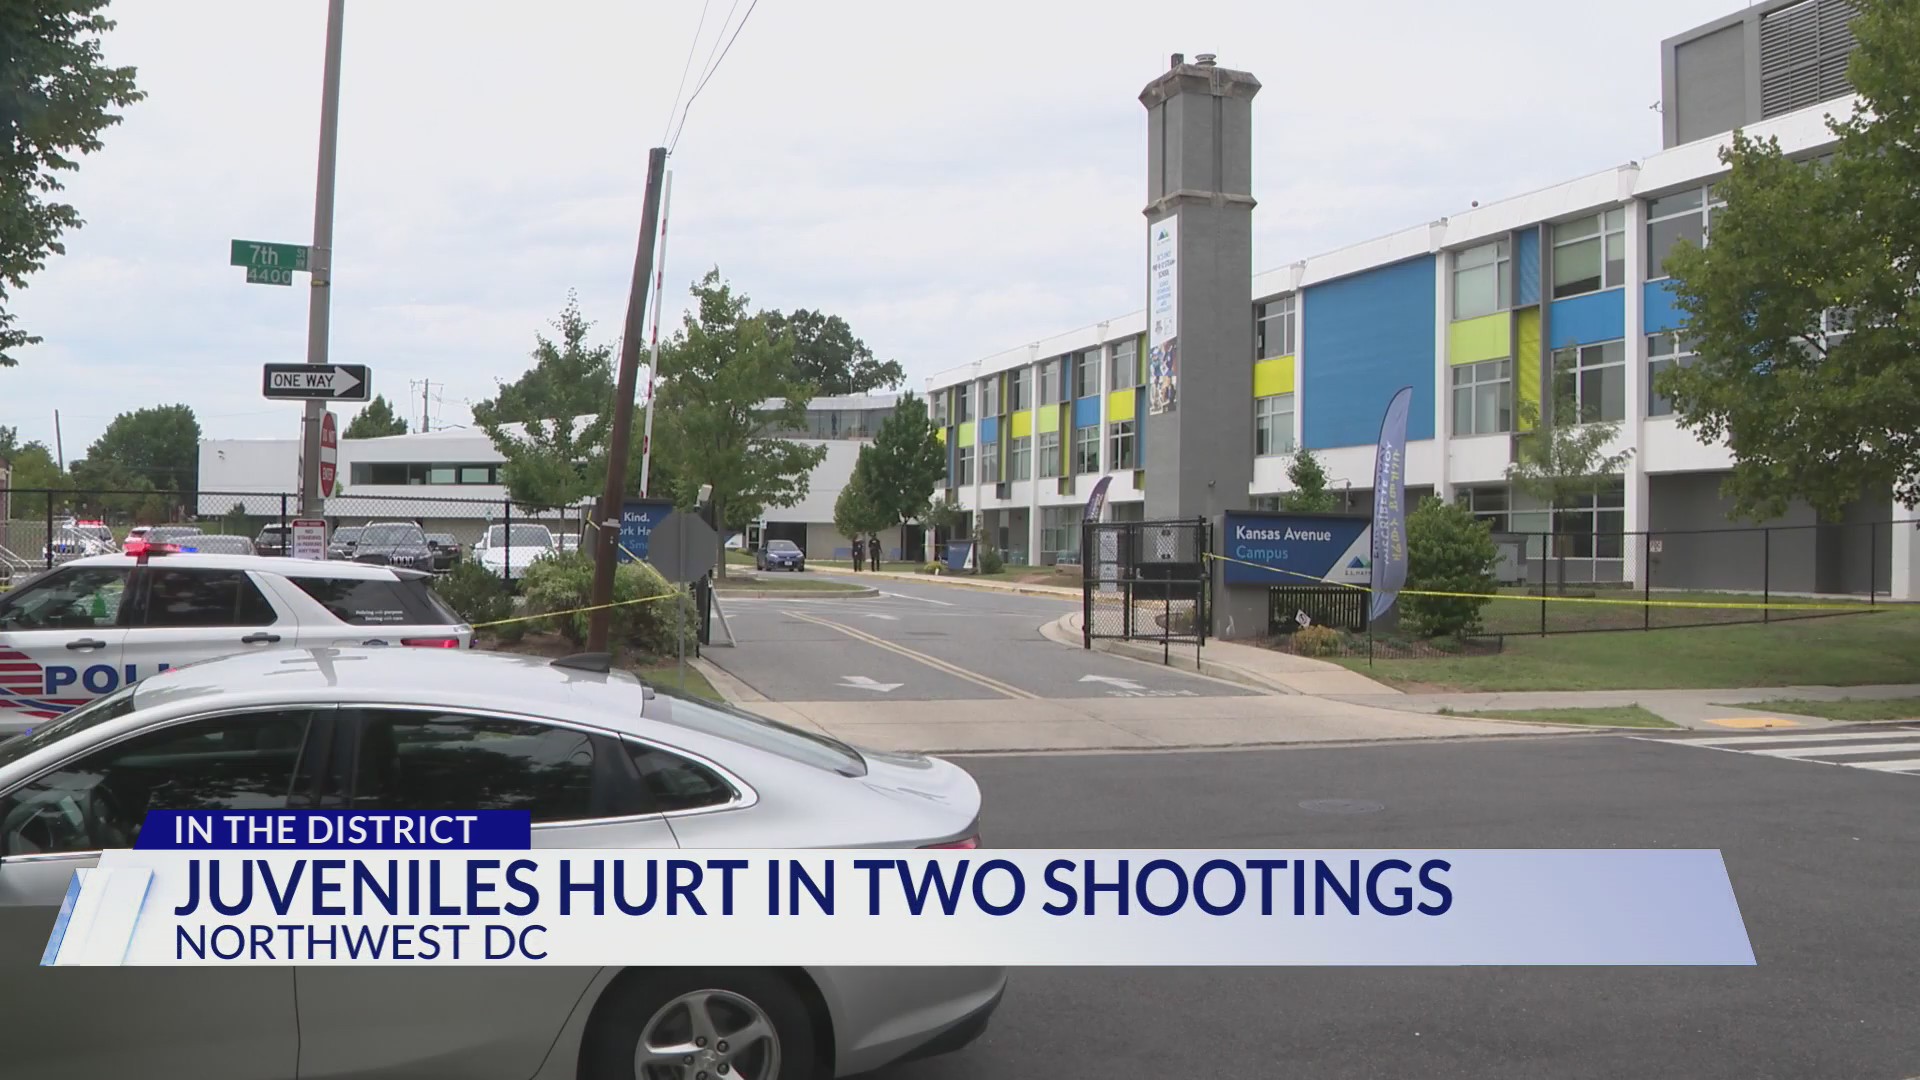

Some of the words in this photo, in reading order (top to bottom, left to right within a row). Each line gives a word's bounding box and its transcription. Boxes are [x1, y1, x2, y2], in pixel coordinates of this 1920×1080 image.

[249, 244, 279, 266] 7th
[248, 267, 291, 284] 4400
[274, 373, 301, 387] ONE
[306, 374, 334, 388] WAY
[624, 512, 650, 522] Kind.
[619, 526, 635, 536] ork
[1236, 525, 1280, 540] Kansas
[1284, 527, 1331, 541] Avenue
[1236, 545, 1288, 562] Campus
[45, 664, 170, 695] POL
